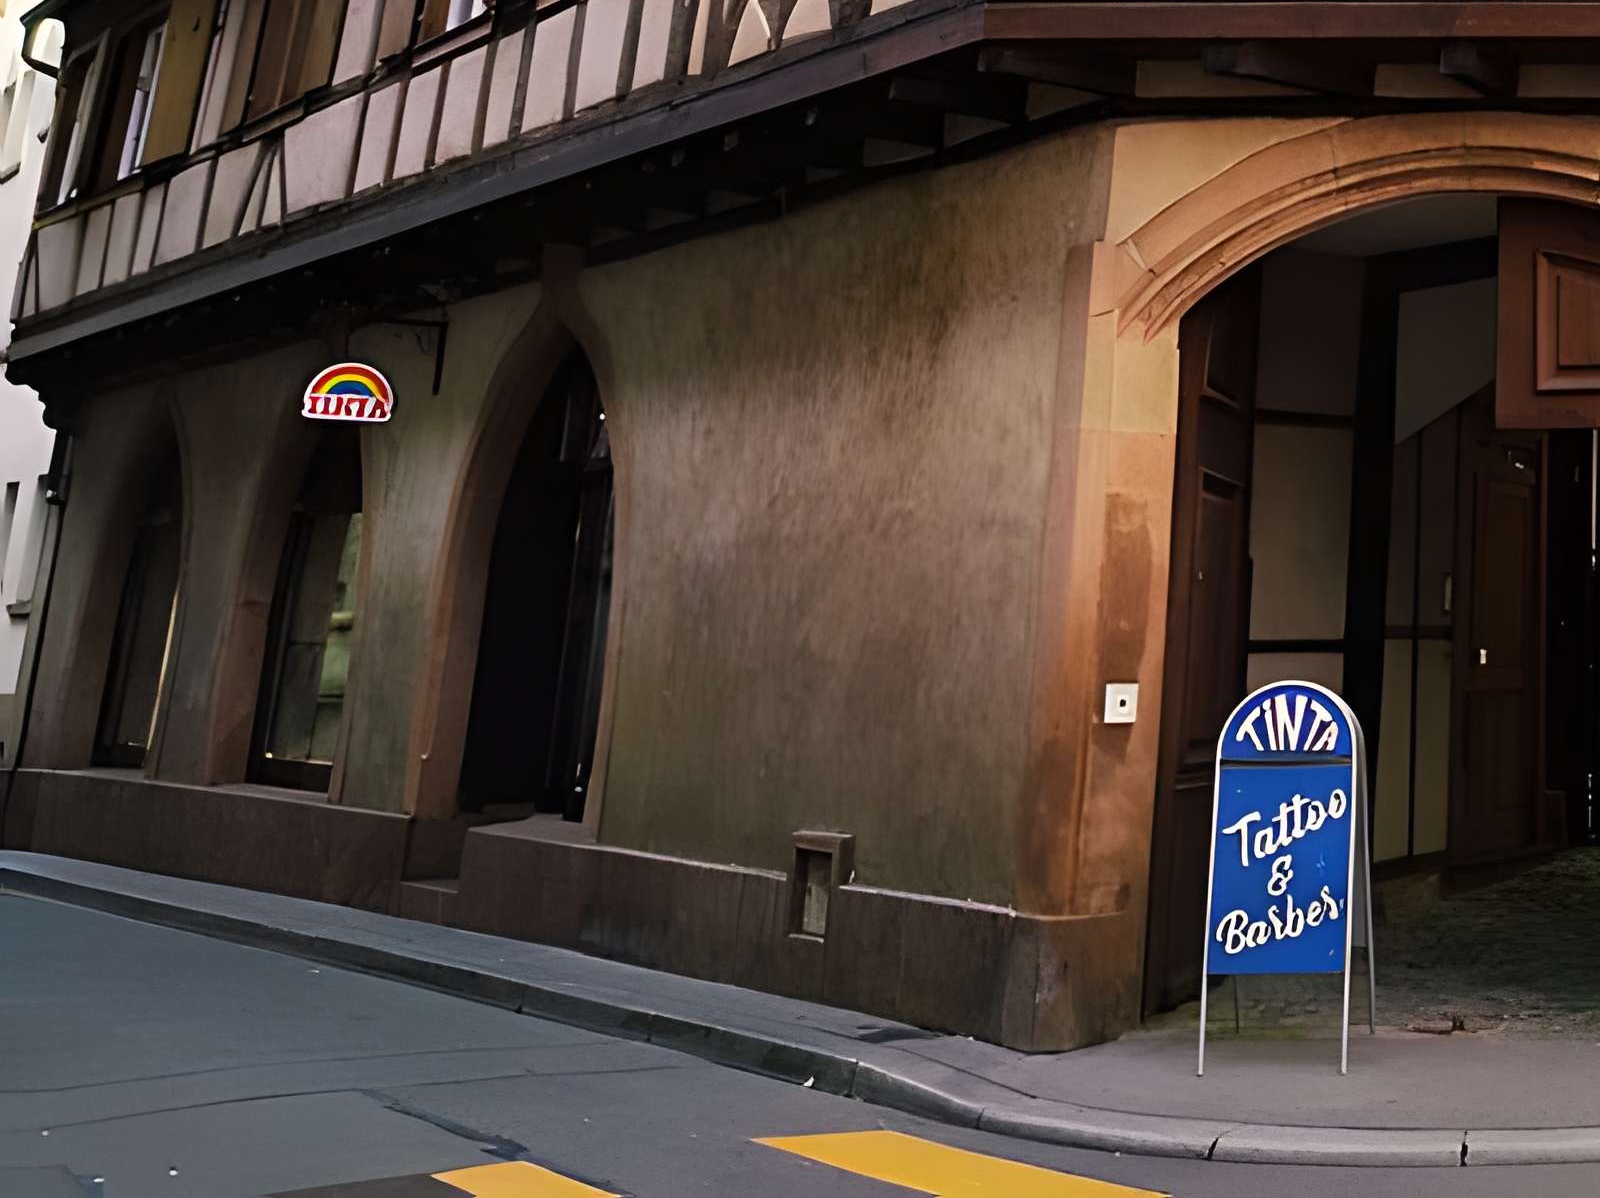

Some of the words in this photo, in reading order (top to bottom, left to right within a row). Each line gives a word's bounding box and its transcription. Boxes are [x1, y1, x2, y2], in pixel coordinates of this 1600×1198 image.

[1222, 788, 1347, 867] Tattoo
[1267, 855, 1294, 896] &
[1216, 885, 1343, 955] Barber
